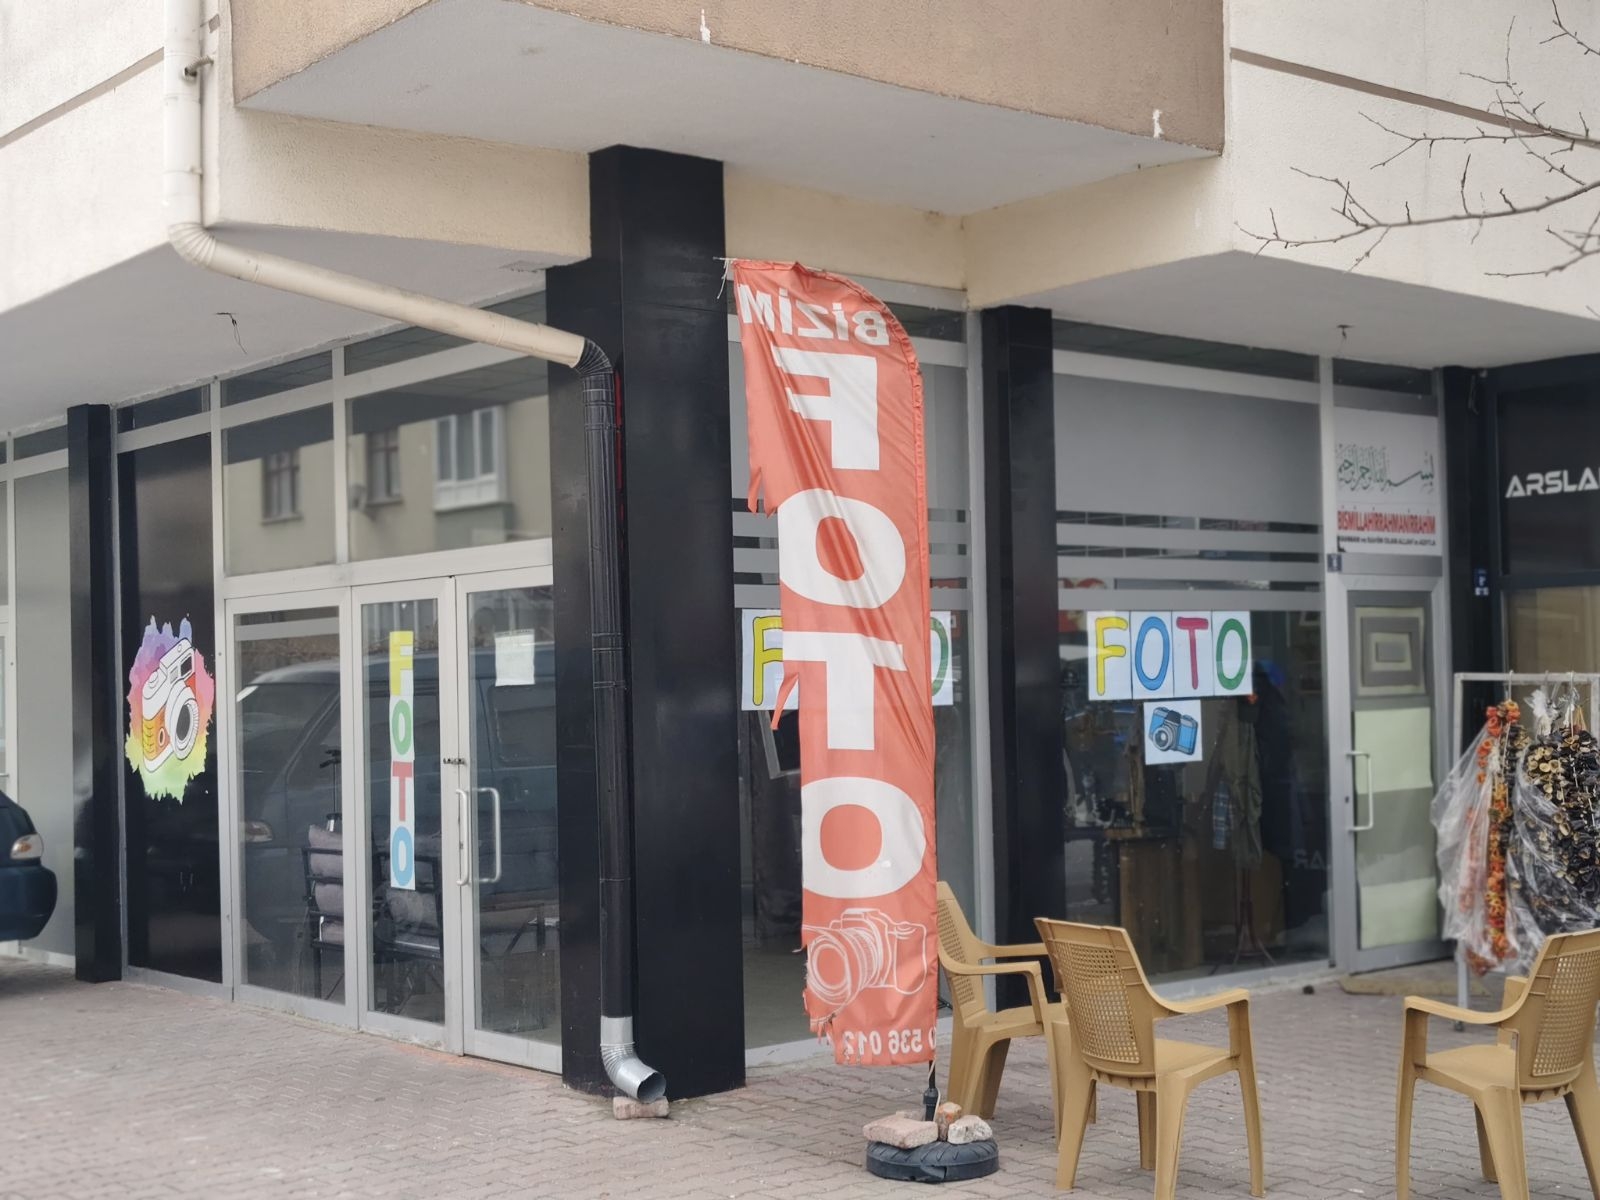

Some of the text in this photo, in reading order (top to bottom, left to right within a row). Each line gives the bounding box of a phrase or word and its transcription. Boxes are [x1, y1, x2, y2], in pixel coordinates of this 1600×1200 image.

[1505, 467, 1600, 498] ARSLA
[1095, 616, 1249, 696] FOTO
[390, 631, 413, 886] FOTO
